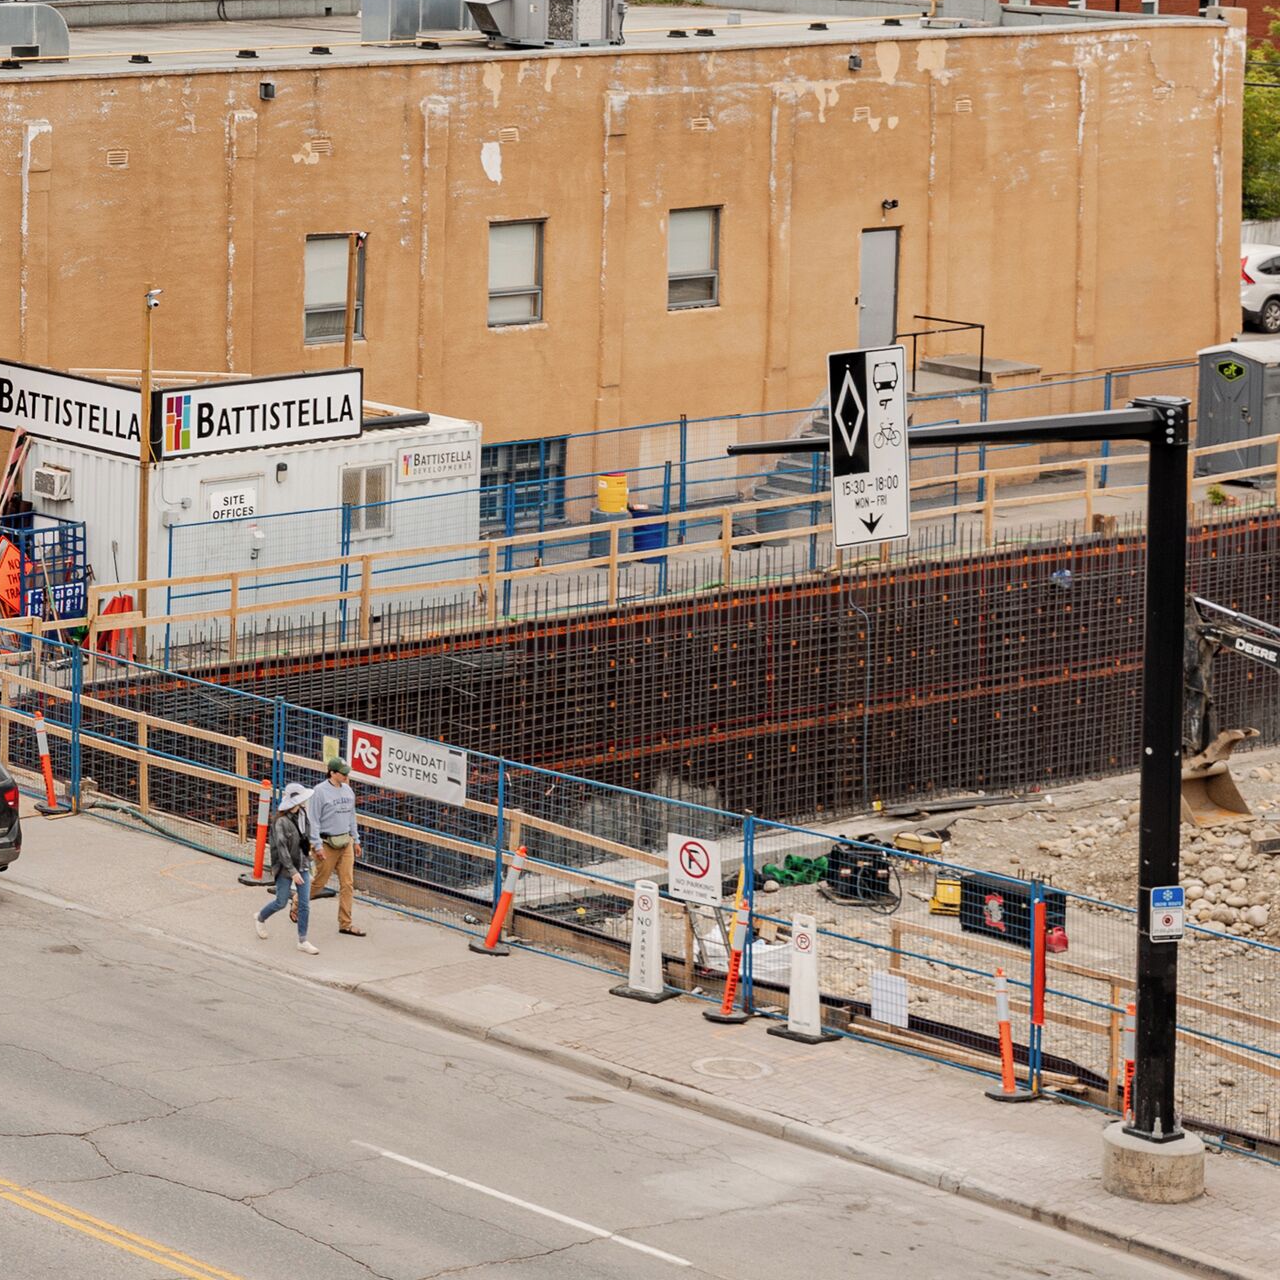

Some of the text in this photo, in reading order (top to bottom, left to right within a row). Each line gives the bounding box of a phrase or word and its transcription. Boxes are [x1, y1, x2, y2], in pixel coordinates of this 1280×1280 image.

[196, 394, 354, 439] BATTISTELLA
[413, 450, 472, 466] BATTISTELLA
[413, 462, 472, 475] DEVELOPMENTS
[842, 479, 866, 496] 15:30
[875, 474, 899, 491] 18:00
[223, 494, 246, 506] SITE
[212, 505, 254, 520] OFFICES
[1234, 637, 1278, 663] DEERE
[353, 737, 380, 770] RS
[387, 747, 447, 772] FOUNDATI
[387, 762, 439, 785] SYSTEMS
[637, 916, 652, 928] NO
